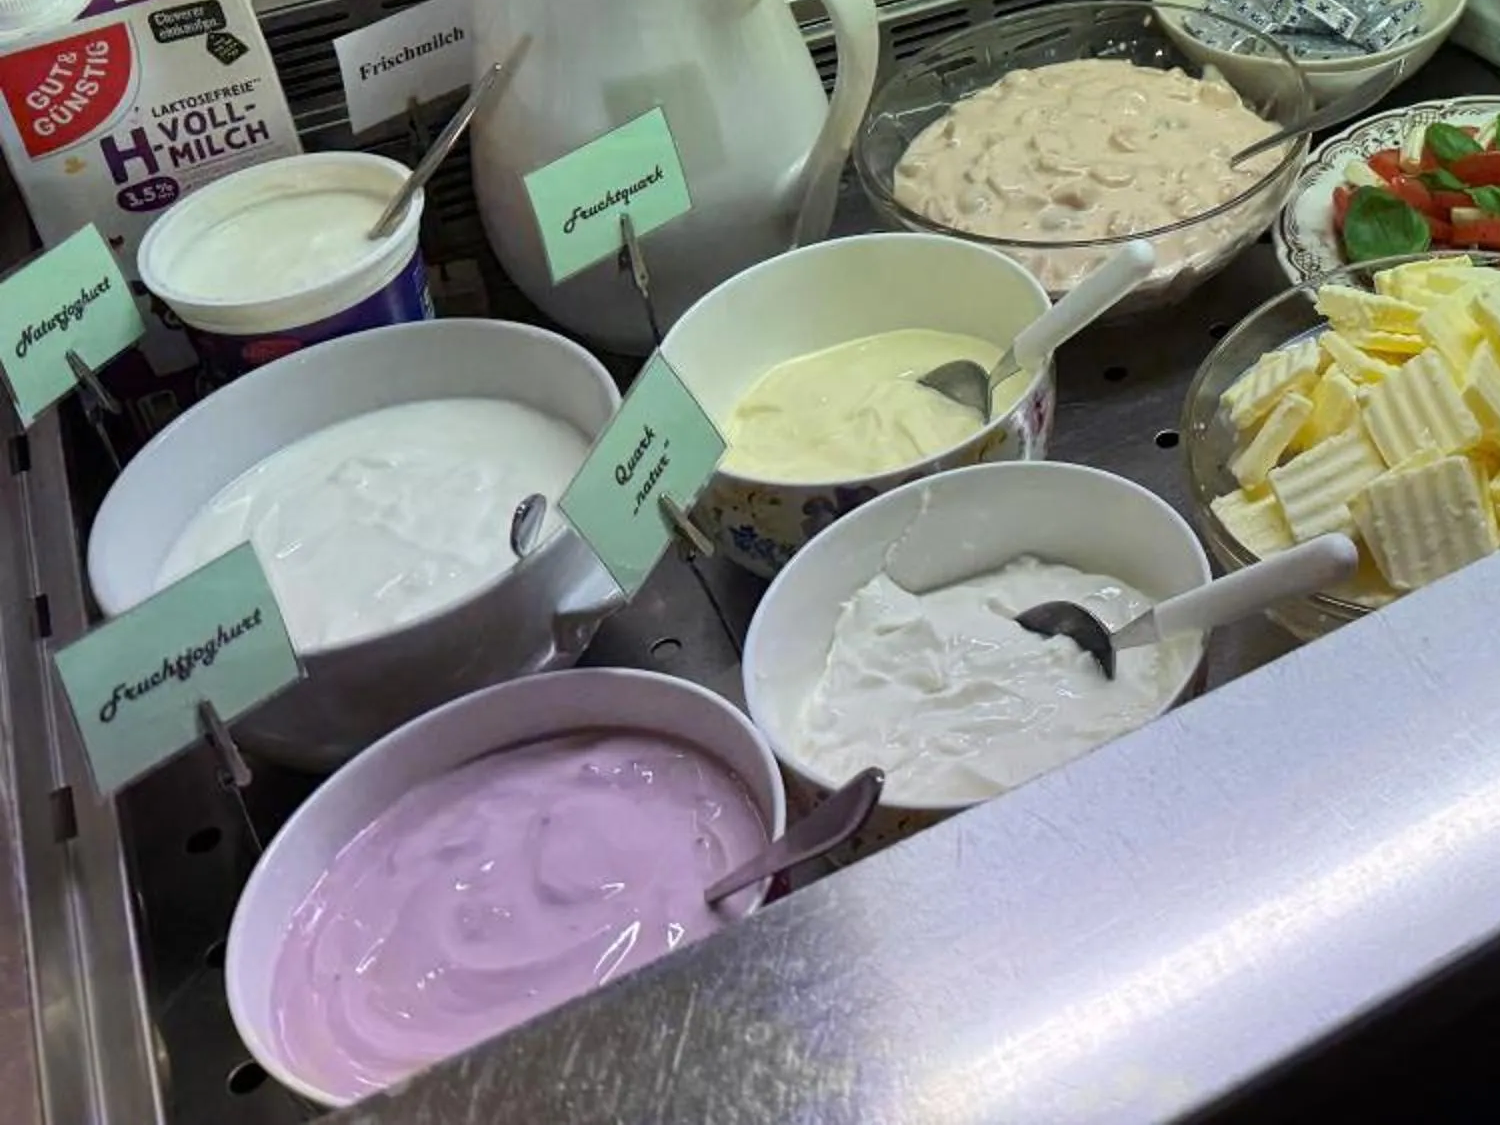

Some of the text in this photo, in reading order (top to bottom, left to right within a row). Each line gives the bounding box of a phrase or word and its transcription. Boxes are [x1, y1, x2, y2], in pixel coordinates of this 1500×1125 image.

[359, 26, 465, 81] Frischmilch
[33, 40, 110, 136] GÜNSTIG
[157, 102, 256, 142] VOLL-
[168, 119, 270, 168] MILCH
[563, 164, 664, 234] Fruchtquark
[15, 276, 111, 359] Naturjoghurt
[615, 423, 656, 486] Quark
[99, 606, 263, 723] Fruchtjoghurt
